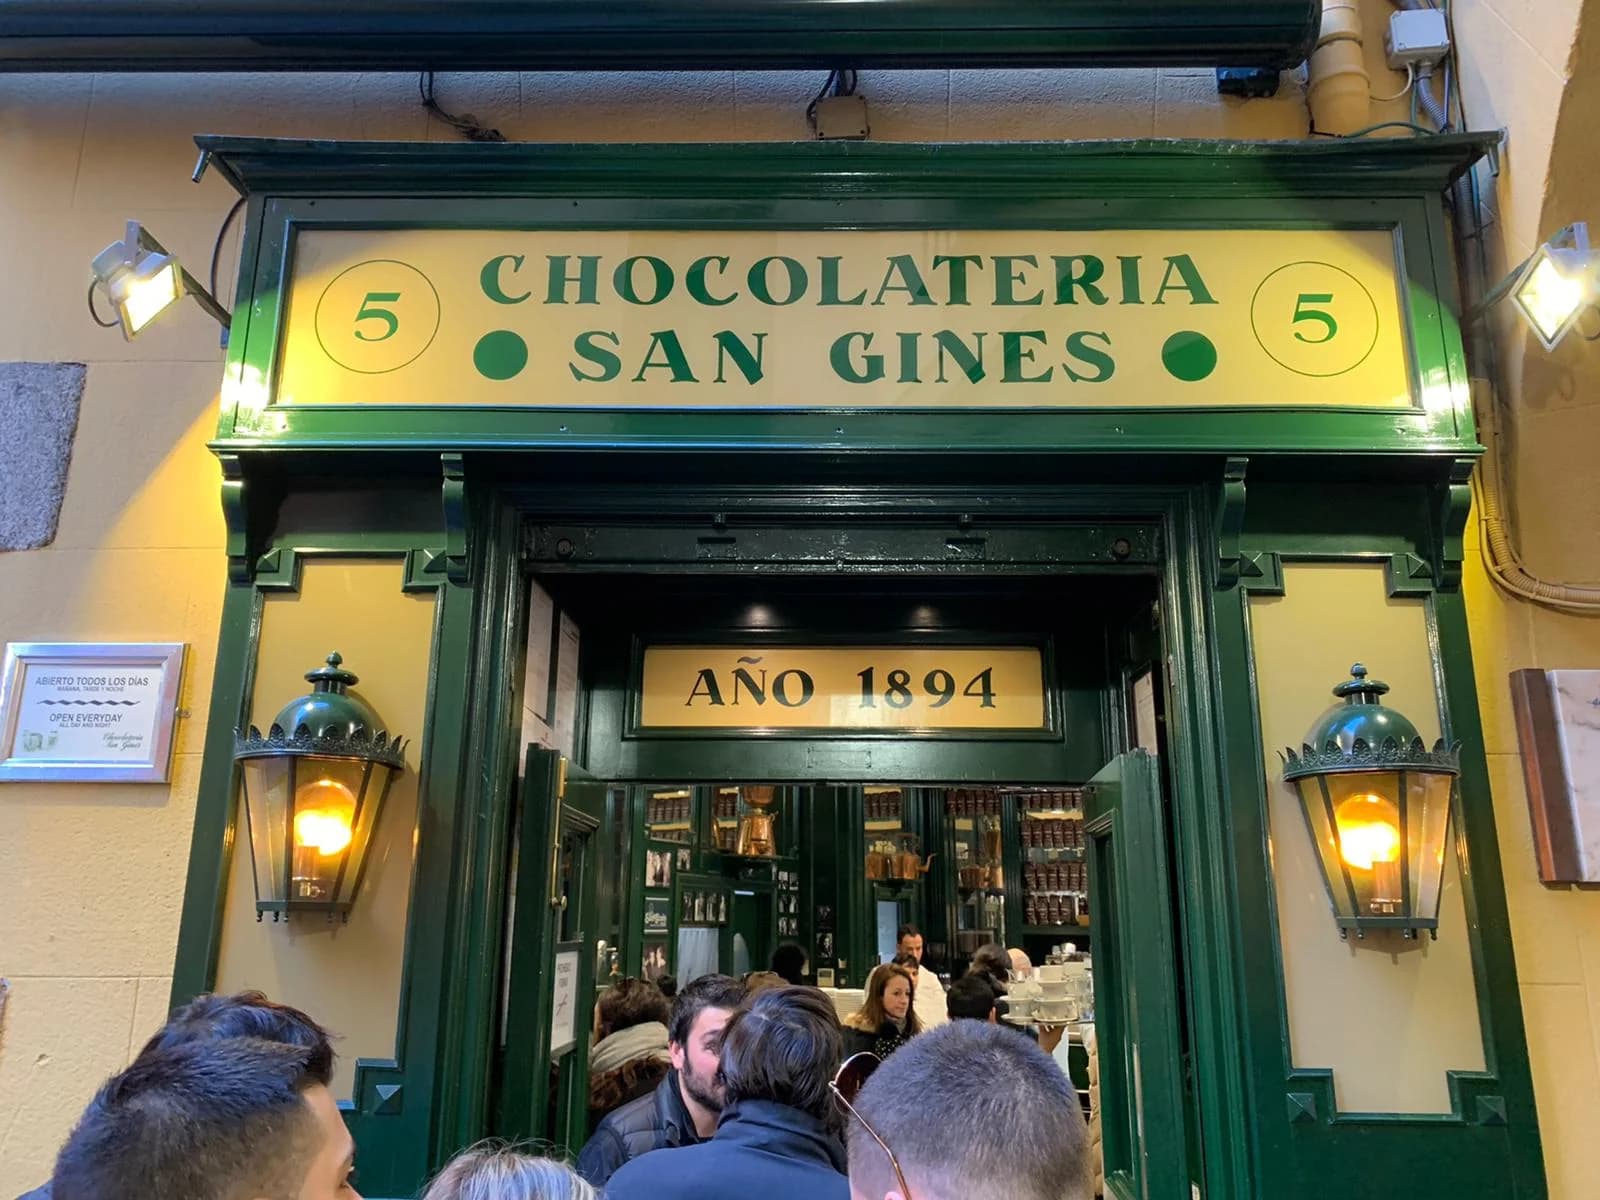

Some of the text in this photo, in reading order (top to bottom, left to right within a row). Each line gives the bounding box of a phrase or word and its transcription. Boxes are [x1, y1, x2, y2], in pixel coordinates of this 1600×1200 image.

[481, 254, 1219, 306] CHOCOLATERIA
[354, 292, 401, 342] 5
[1292, 293, 1338, 344] 5
[569, 329, 1116, 385] SAN GINES
[36, 675, 149, 687] ABIERTO TODOS LOS DÍAS
[685, 656, 997, 708] AÑO 1894
[49, 713, 123, 722] OPEN EVERYDAY
